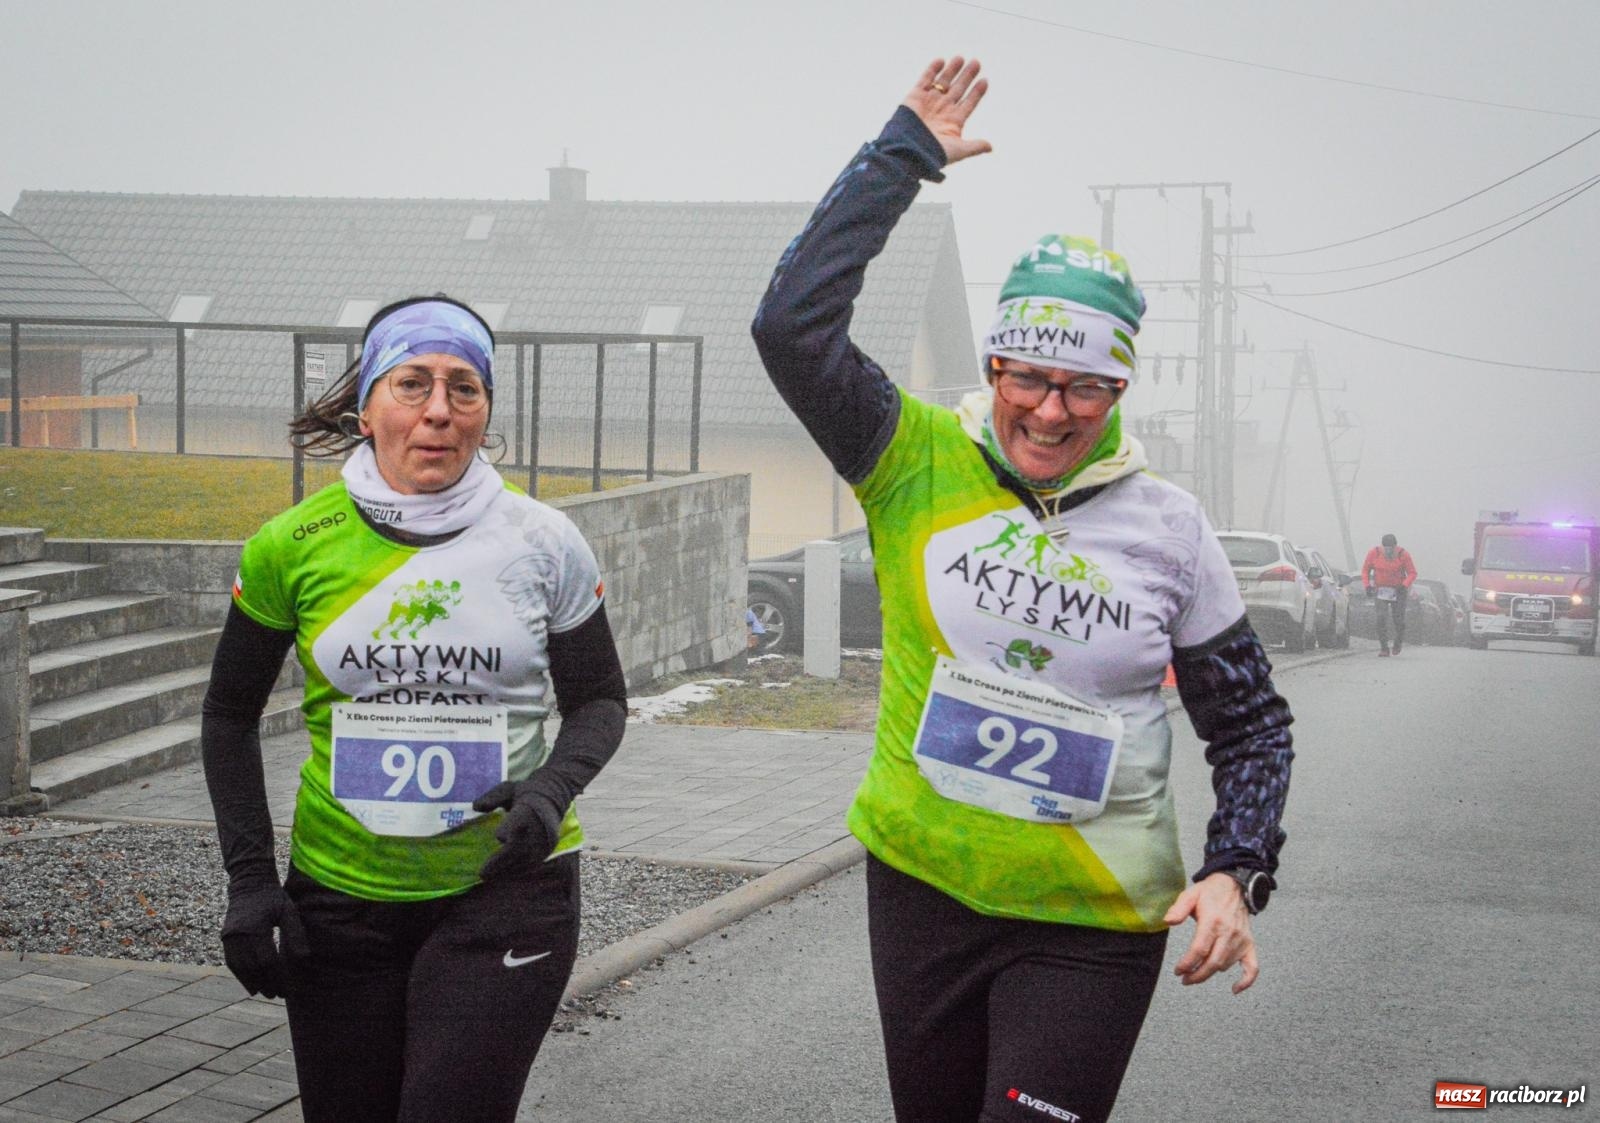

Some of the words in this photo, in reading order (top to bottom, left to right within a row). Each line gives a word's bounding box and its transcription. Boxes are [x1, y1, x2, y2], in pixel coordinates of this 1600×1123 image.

[293, 512, 347, 541] deep
[944, 552, 1130, 631] AKTYWNI
[976, 591, 1091, 641] LYSKI
[340, 644, 501, 672] AKTYWNI
[376, 669, 467, 686] LYSKI
[974, 677, 1001, 692] Cross
[1002, 688, 1015, 697] po
[1016, 690, 1044, 704] Ziemi
[354, 713, 368, 721] Eko
[370, 714, 394, 722] Cross
[396, 715, 406, 724] po
[408, 715, 433, 723] Ziemi
[434, 716, 493, 726] Pietrowickiej
[974, 716, 1058, 785] 92
[381, 744, 456, 799] 90
[1018, 1092, 1080, 1123] EVEREST
